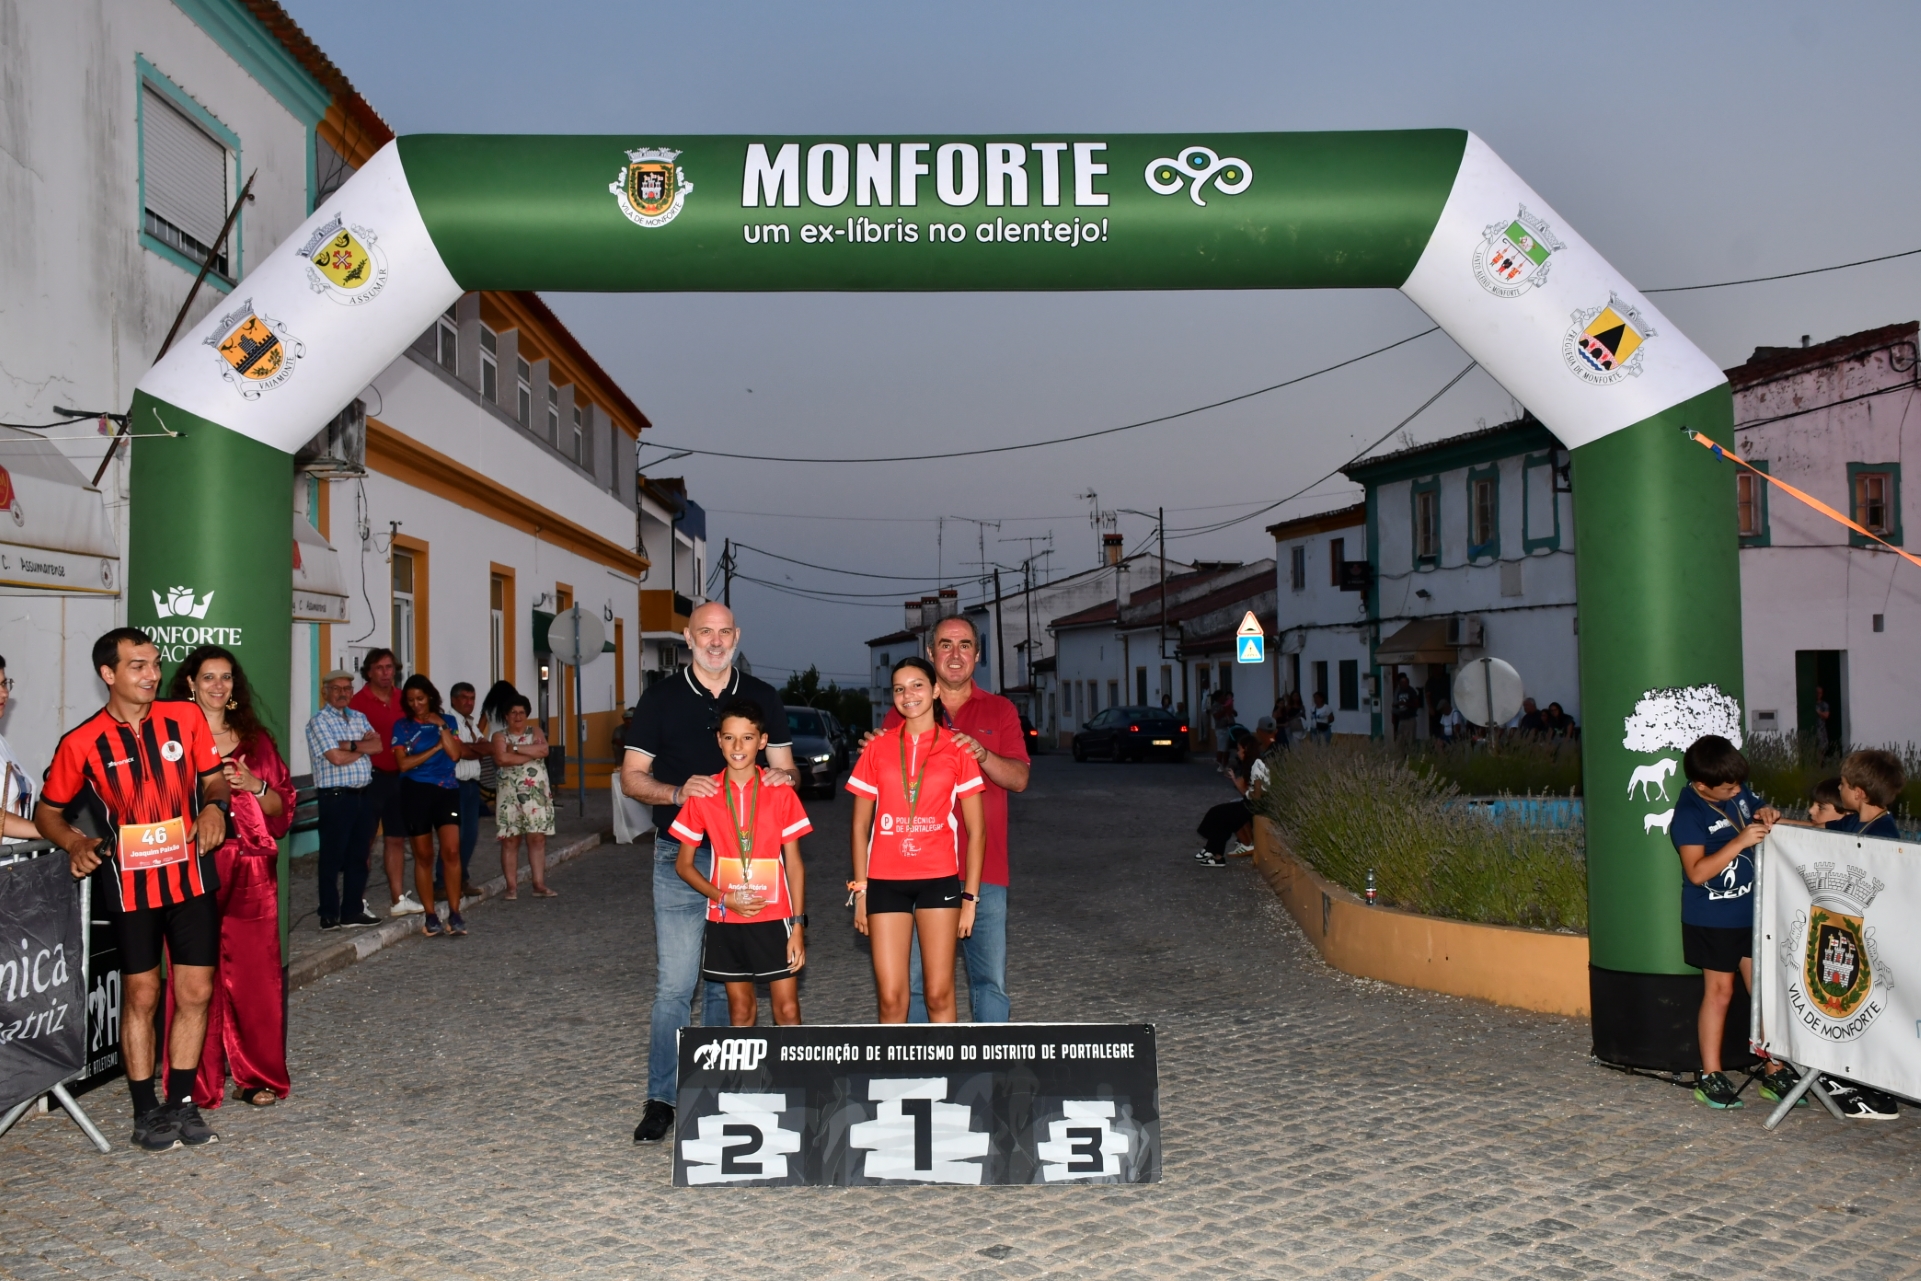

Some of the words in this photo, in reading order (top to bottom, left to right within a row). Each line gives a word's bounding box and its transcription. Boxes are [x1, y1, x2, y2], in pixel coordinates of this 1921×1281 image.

[742, 142, 1110, 207] MONFORTE
[621, 202, 634, 218] VILA
[634, 214, 644, 224] DE
[646, 202, 681, 226] MONFORTE
[744, 224, 790, 243] um
[800, 216, 919, 243] ex-líbris
[929, 223, 967, 243] no
[976, 216, 1109, 248] alentejo!
[349, 269, 386, 304] ASSUMAR
[259, 356, 294, 389] VAIAMONTE
[1583, 372, 1622, 383] MONFORTE
[135, 626, 242, 645] ONFORTE
[142, 826, 167, 845] 46
[130, 849, 159, 857] Joaquim
[1788, 983, 1806, 1015] VILA
[1803, 1011, 1821, 1031] DE
[1820, 1001, 1881, 1039] MONFORTE
[719, 1039, 767, 1071] AADP
[780, 1043, 859, 1064] ASSOCIAÇÃO
[866, 1046, 881, 1061] DE
[887, 1045, 954, 1061] ATLETISMO
[961, 1045, 977, 1060] DO
[982, 1044, 1036, 1060] DISTRITO
[1041, 1044, 1056, 1060] DE
[1061, 1043, 1135, 1059] PORTALEGRE
[721, 1124, 764, 1175] 2
[901, 1098, 933, 1171] 1
[1066, 1127, 1104, 1173] 3
